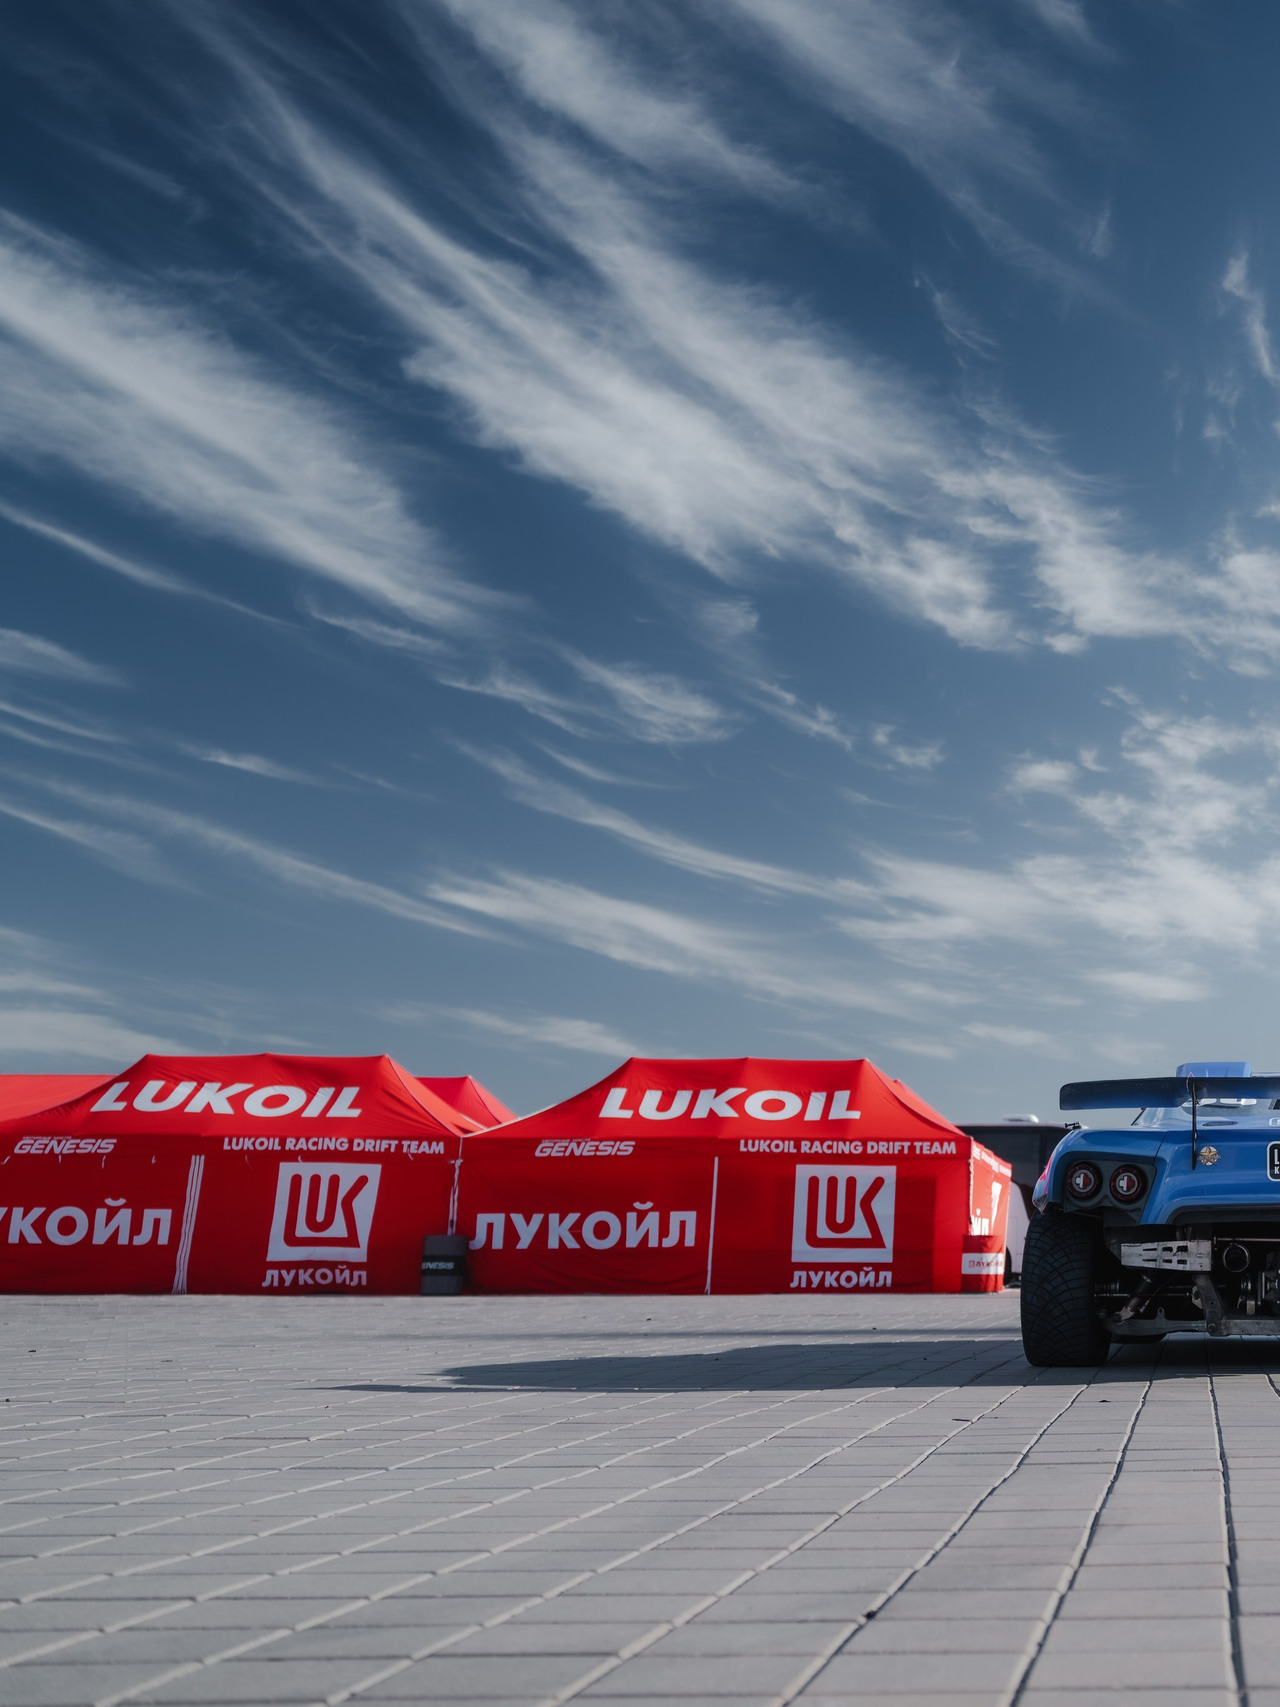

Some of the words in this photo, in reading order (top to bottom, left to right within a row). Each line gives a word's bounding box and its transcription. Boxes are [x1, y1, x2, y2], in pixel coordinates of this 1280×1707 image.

[90, 1080, 362, 1118] LUKOIL
[599, 1087, 861, 1121] LUKOIL
[14, 1139, 117, 1154] GENESIS
[224, 1137, 281, 1151] LUKOIL
[285, 1138, 349, 1151] RACING
[352, 1139, 399, 1152] DRIFT
[402, 1141, 444, 1154] TEAM
[535, 1141, 636, 1157] GENESIS
[740, 1140, 797, 1153] LUKOIL
[801, 1141, 863, 1154] RACING
[867, 1141, 910, 1154] DRIFT
[914, 1142, 956, 1154] TEAM
[0, 1198, 172, 1246] КОЙЛ
[469, 1202, 697, 1250] ЛУКОЙЛ
[262, 1266, 366, 1287] ЛУКОЙЛ
[790, 1267, 892, 1288] ЛУКОЙЛ
